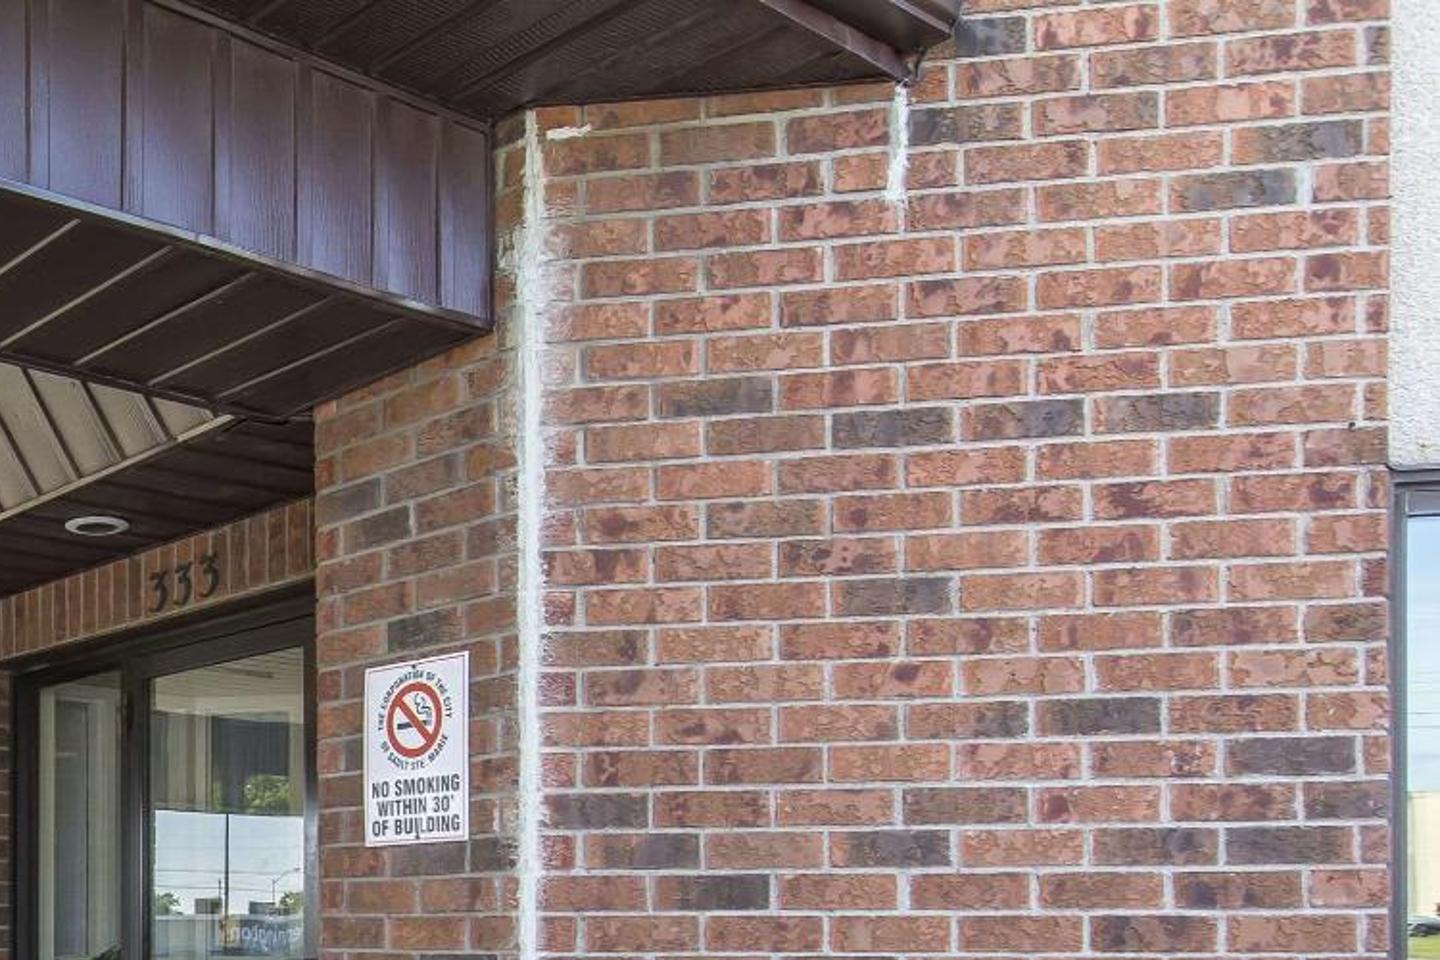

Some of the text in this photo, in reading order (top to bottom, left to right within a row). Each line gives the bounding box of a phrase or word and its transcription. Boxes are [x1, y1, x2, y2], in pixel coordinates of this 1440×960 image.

[149, 552, 219, 612] 333
[372, 773, 460, 799] NO SMOKING
[376, 794, 454, 817] WITHIN 30'
[372, 814, 461, 837] OF BUILDING
